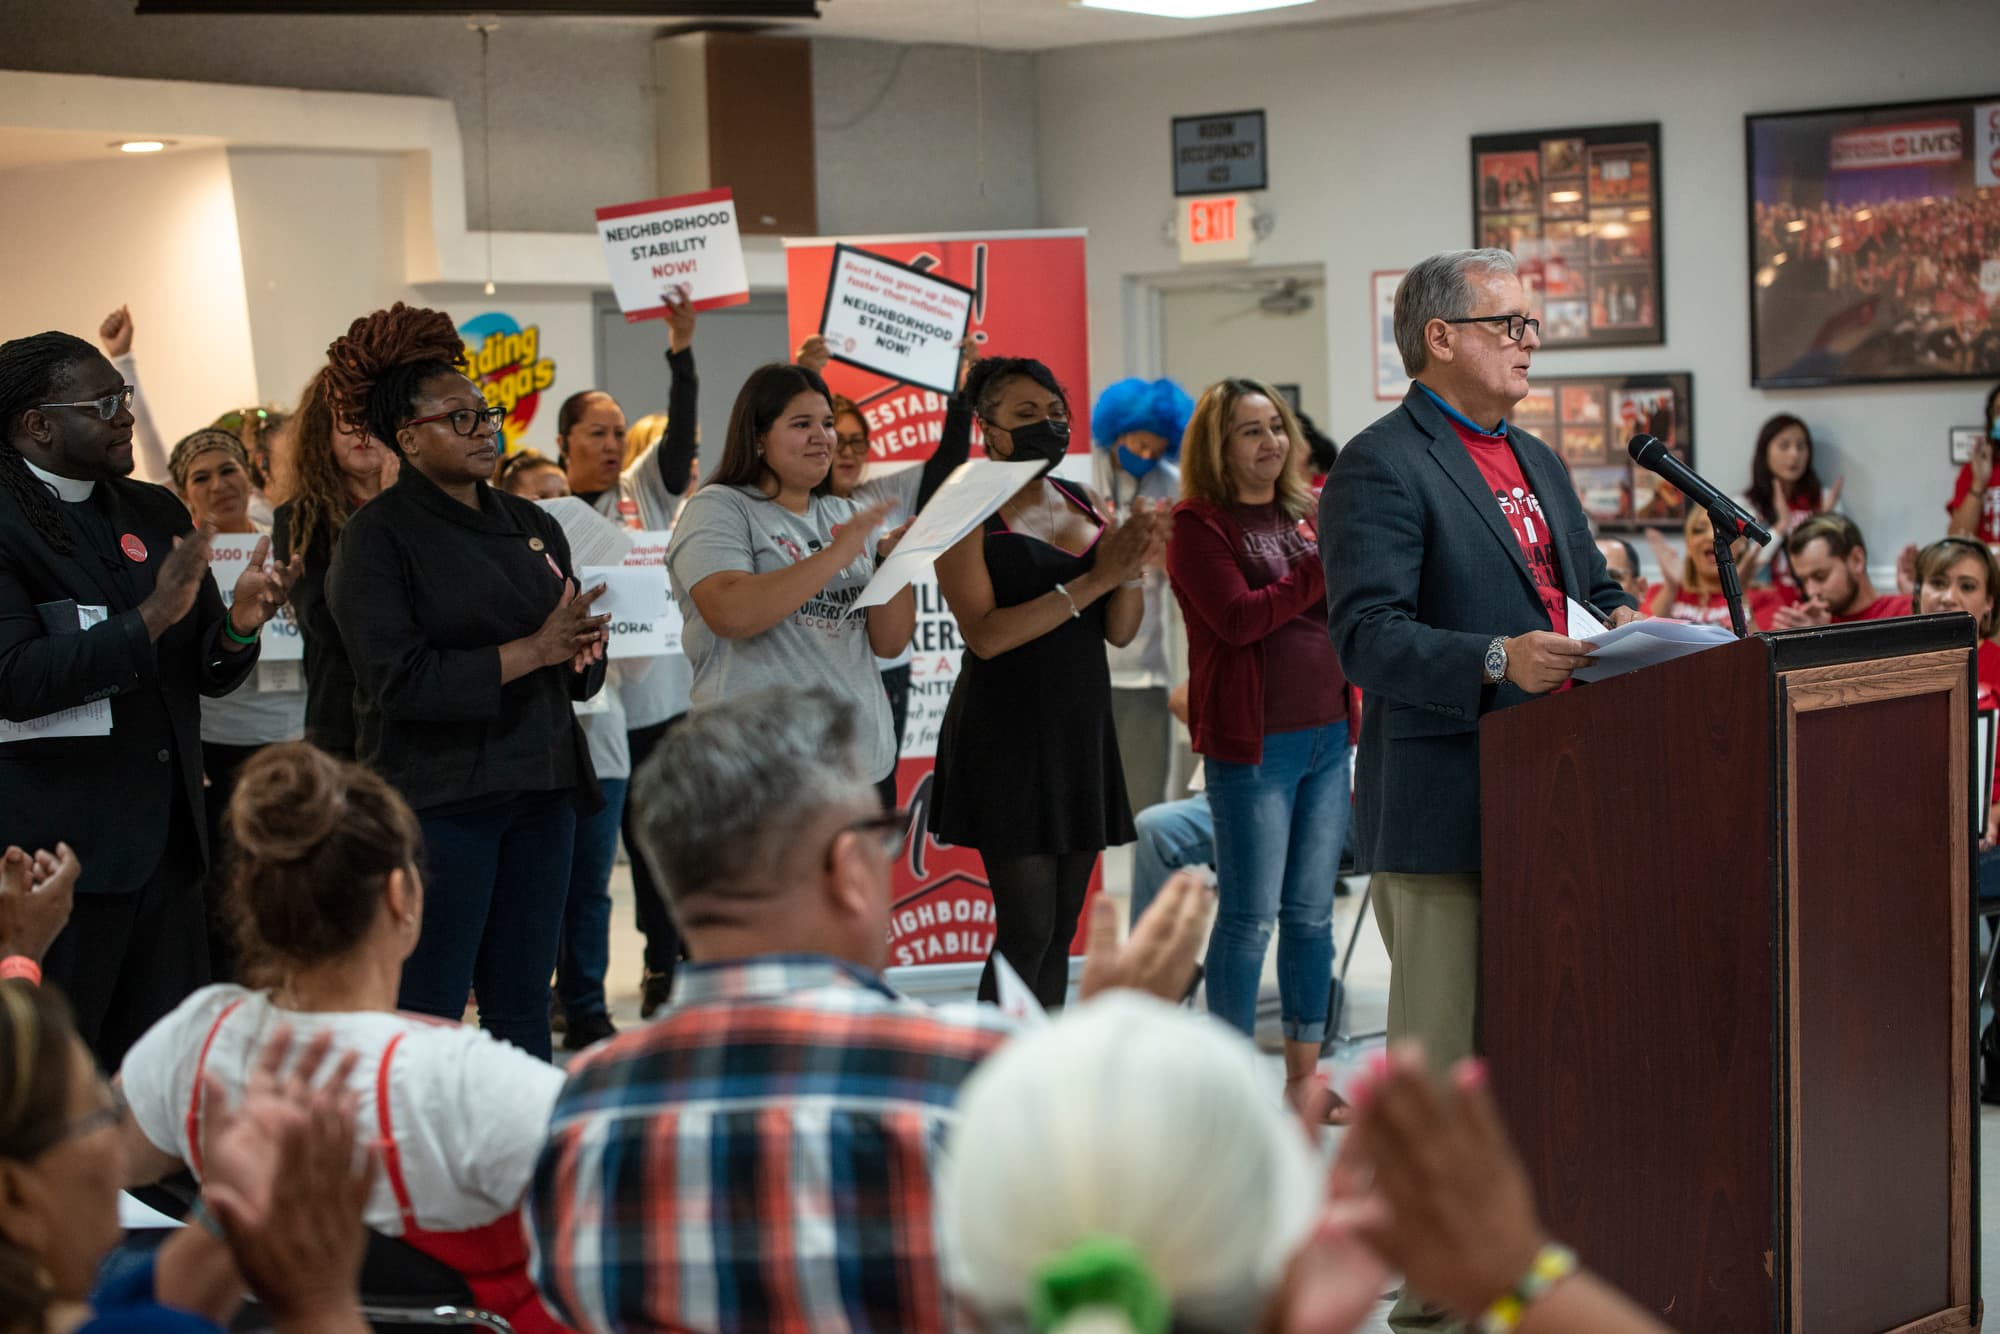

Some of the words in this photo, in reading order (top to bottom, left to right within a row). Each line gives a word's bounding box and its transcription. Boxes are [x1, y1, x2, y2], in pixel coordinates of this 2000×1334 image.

[606, 211, 730, 242] NEIGHBORHOOD
[1189, 197, 1237, 244] EXIT
[631, 236, 707, 261] STABILITY
[652, 259, 697, 279] NOW!
[844, 261, 872, 275] Rent
[875, 270, 894, 285] has
[847, 276, 879, 293] faster
[882, 285, 906, 301] than
[843, 294, 953, 341] NEIGHBORHOOD
[858, 315, 928, 347] STABILITY
[875, 336, 911, 357] NOW!
[869, 420, 943, 458] VECIN
[896, 931, 994, 966] STABILI
